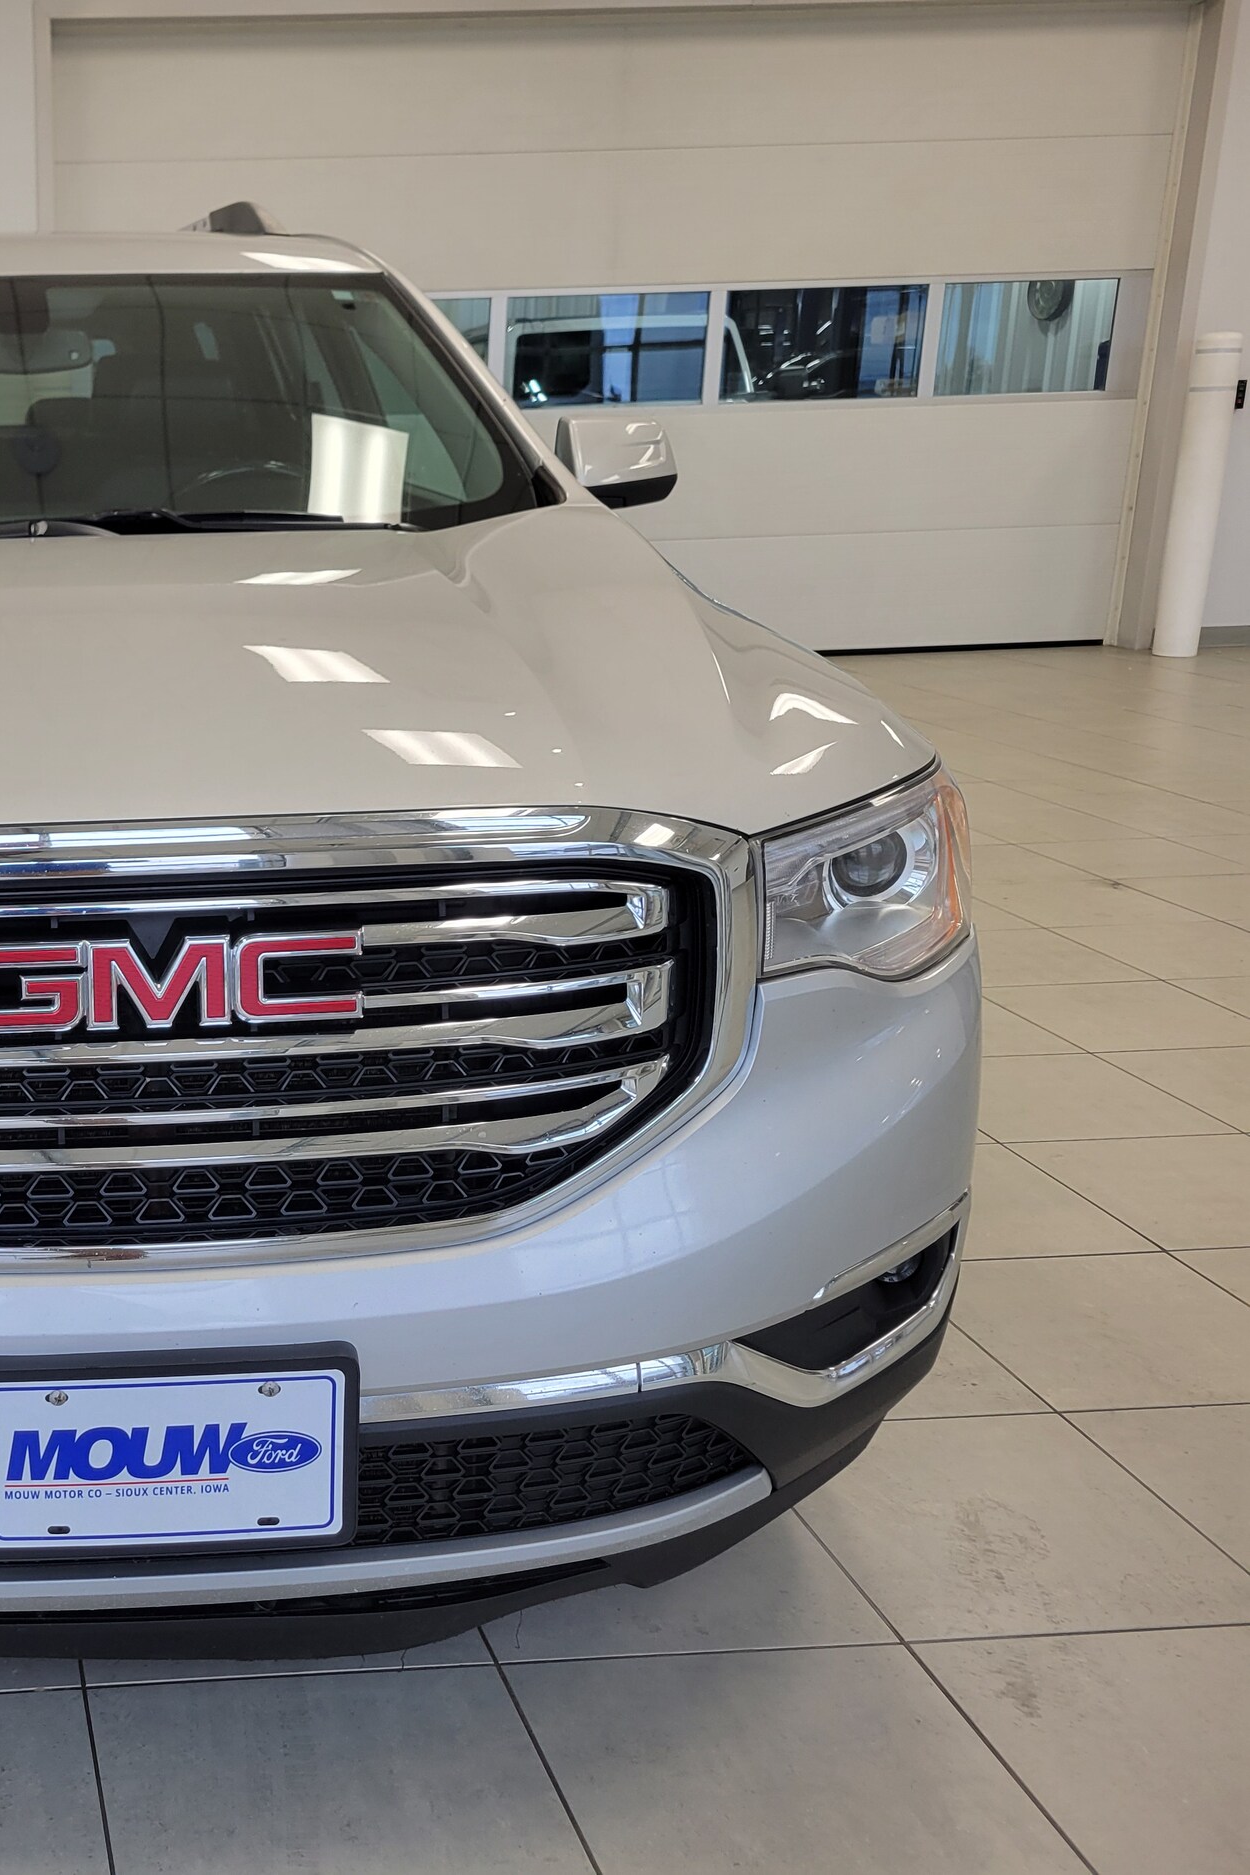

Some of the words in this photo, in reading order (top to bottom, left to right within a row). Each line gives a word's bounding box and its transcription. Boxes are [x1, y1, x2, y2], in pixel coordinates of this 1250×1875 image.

[6, 1422, 247, 1481] MOUW
[247, 1438, 302, 1465] Ford
[4, 1490, 40, 1500] MOUW
[44, 1489, 84, 1500] MOTOR
[87, 1489, 102, 1498] CO
[115, 1487, 149, 1498] SIOUX
[200, 1483, 230, 1494] IOWA
